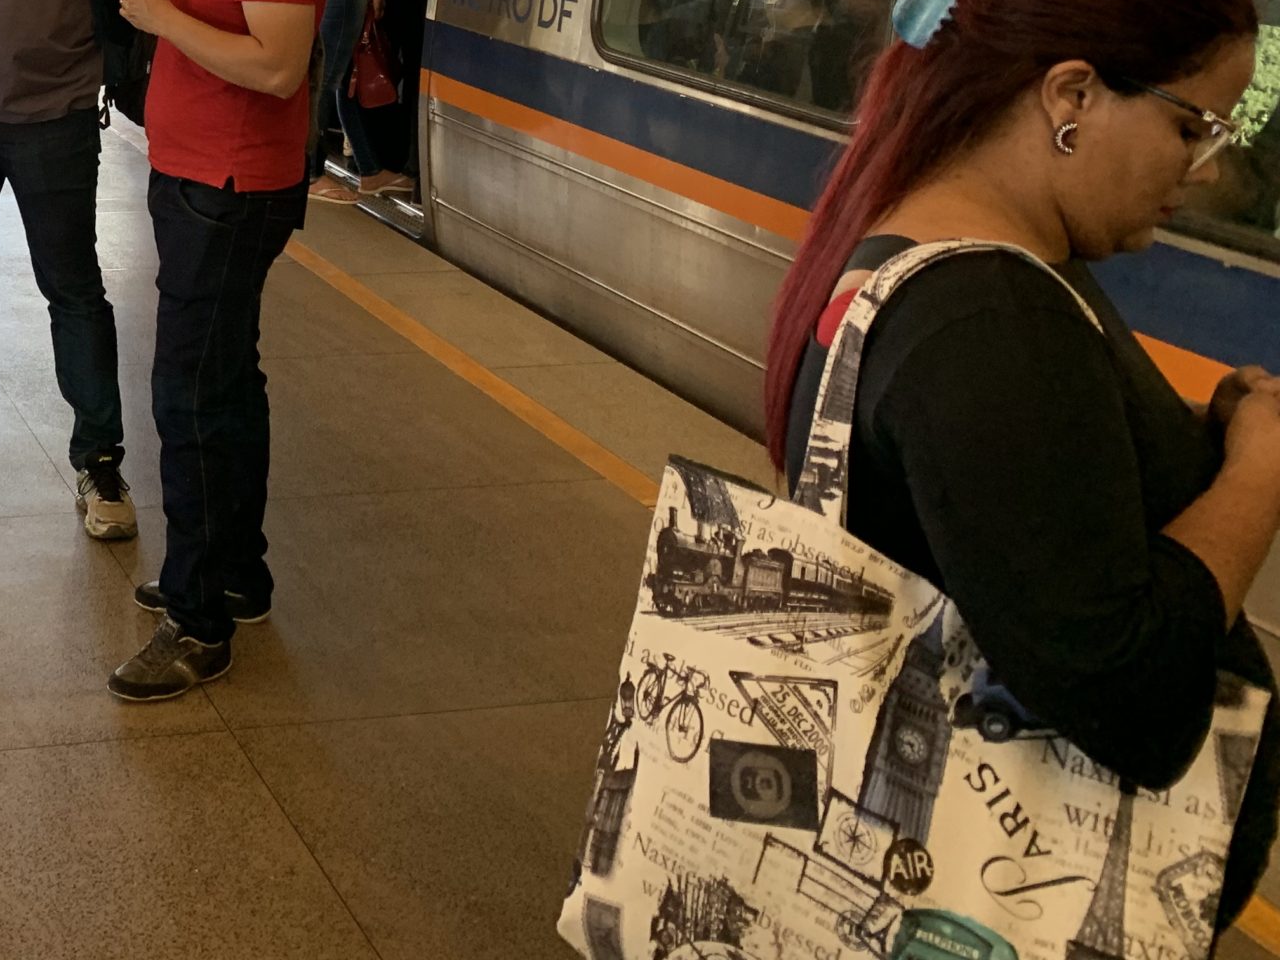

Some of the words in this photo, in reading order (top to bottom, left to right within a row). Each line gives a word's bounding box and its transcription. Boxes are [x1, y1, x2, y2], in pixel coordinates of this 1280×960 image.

[786, 705, 805, 730] DEC
[801, 721, 829, 757] 2000
[889, 849, 932, 881] AIR
